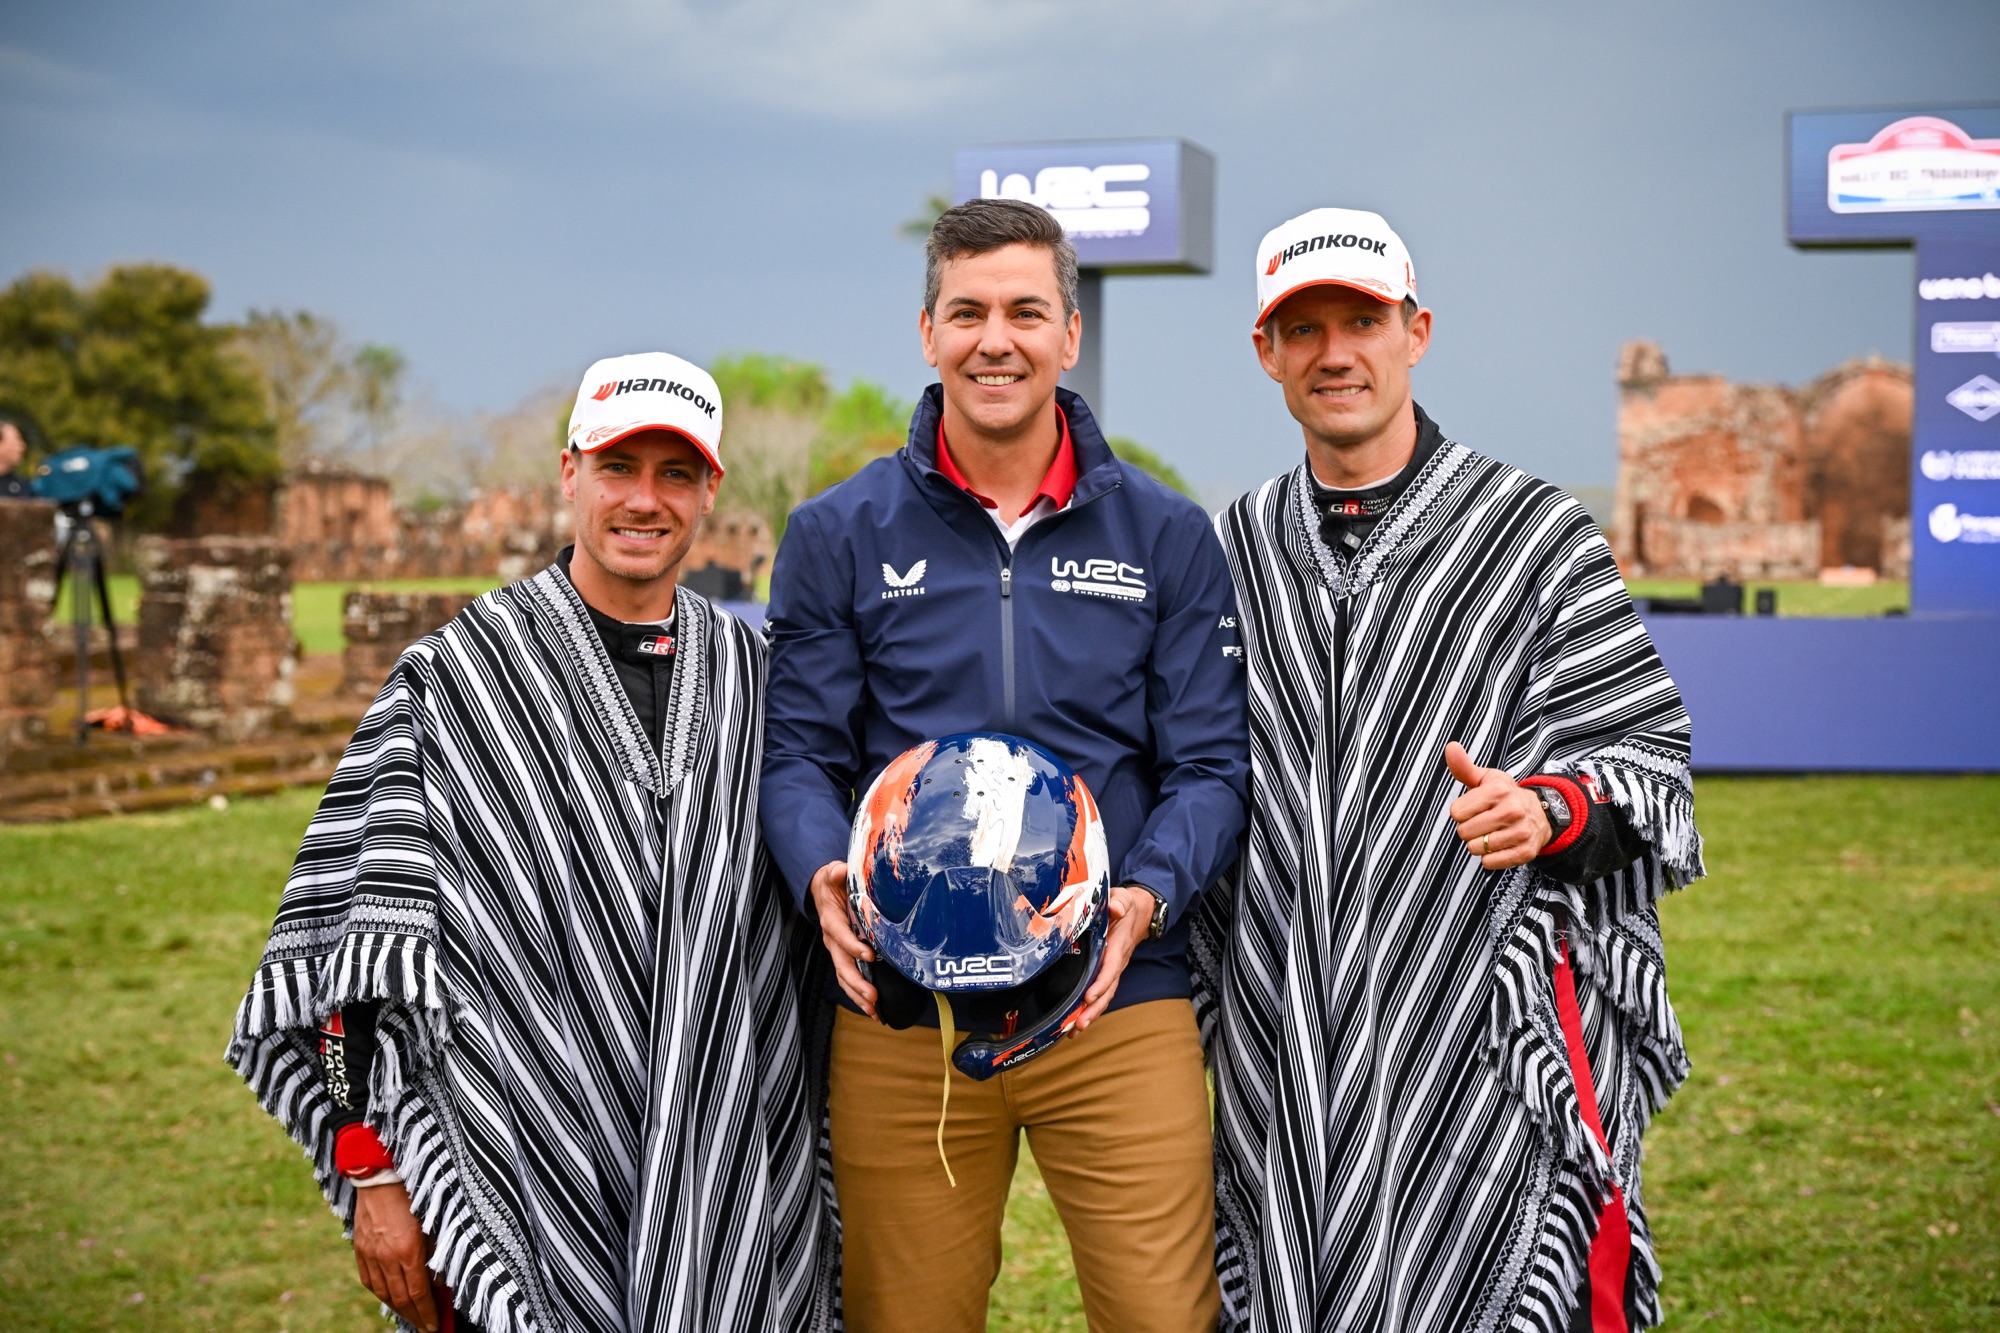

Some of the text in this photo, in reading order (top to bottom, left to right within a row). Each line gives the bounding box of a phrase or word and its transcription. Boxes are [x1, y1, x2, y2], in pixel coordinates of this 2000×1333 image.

[1330, 503, 1358, 515] GR
[1052, 556, 1146, 586] WRC
[882, 587, 926, 599] CASTORE
[640, 641, 668, 654] GR
[936, 956, 1012, 975] WRC
